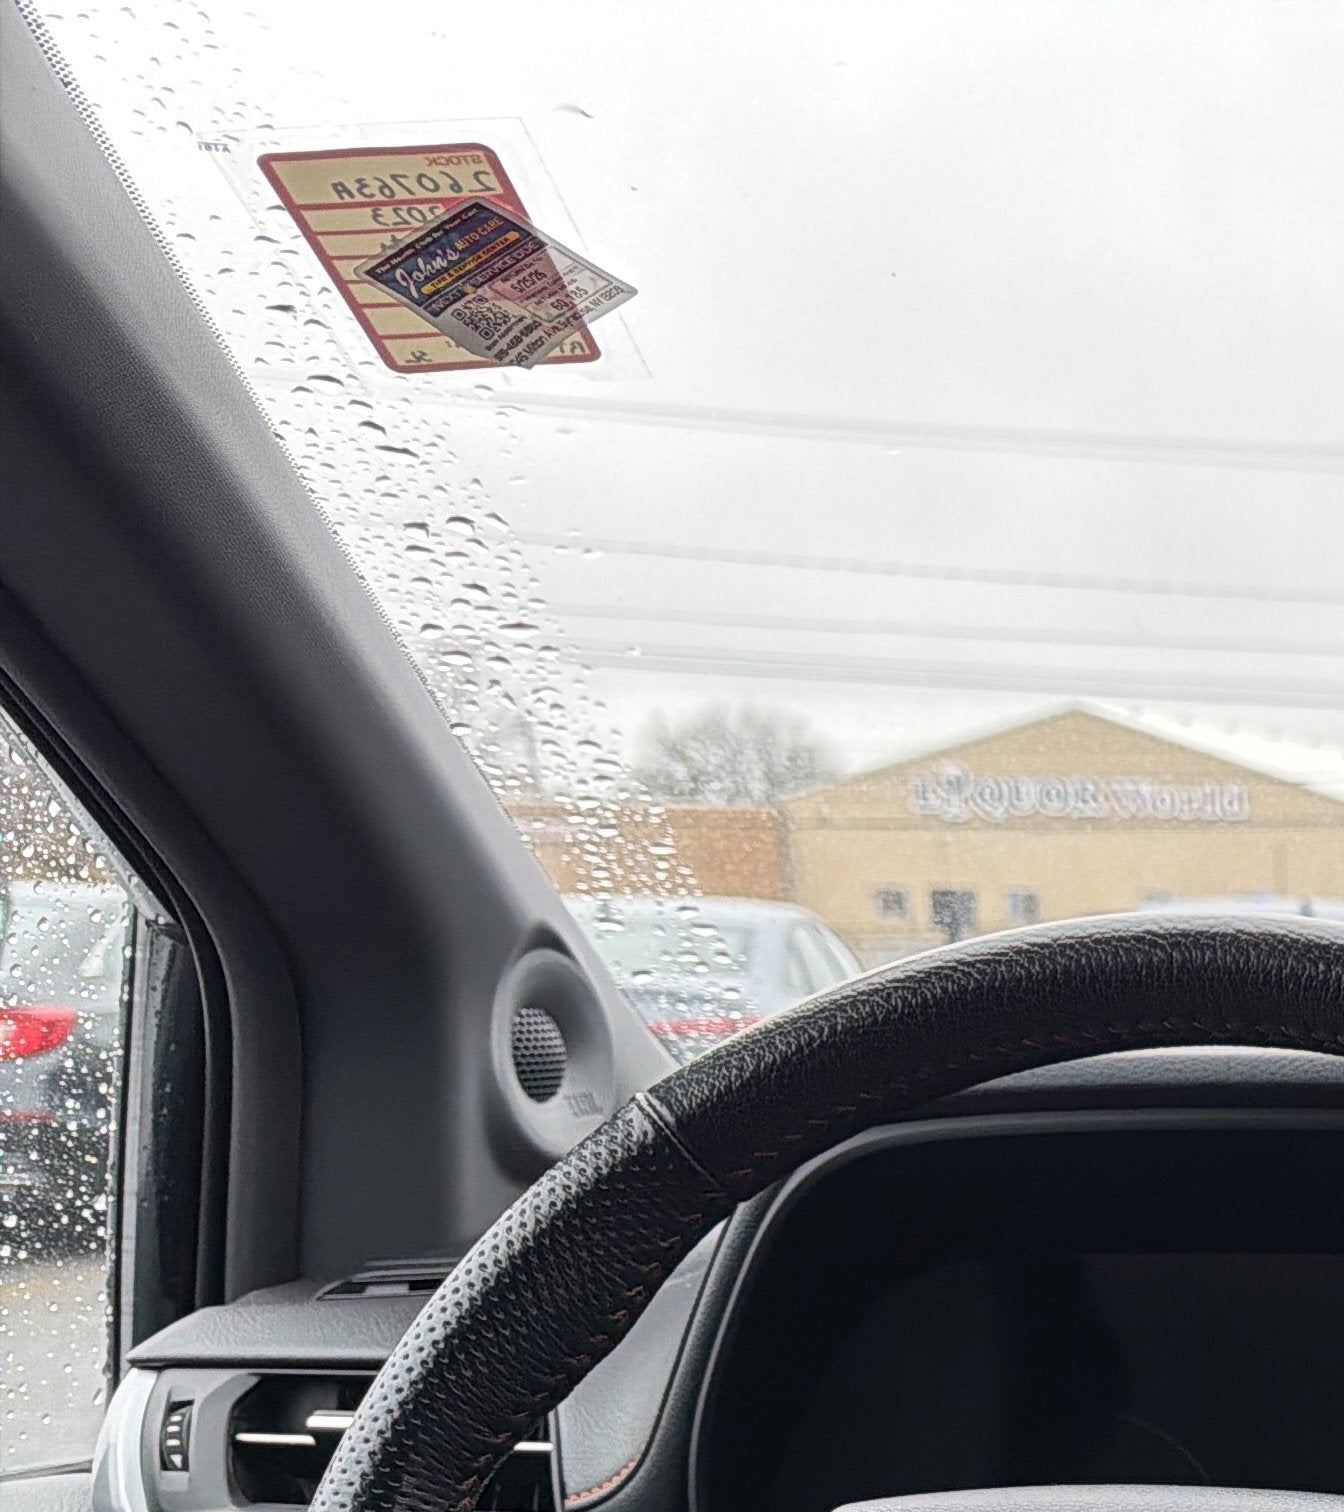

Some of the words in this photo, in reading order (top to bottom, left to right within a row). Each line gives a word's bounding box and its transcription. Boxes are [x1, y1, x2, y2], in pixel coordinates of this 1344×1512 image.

[455, 232, 480, 251] AUTO
[479, 217, 505, 238] CARE
[395, 248, 460, 299] John's
